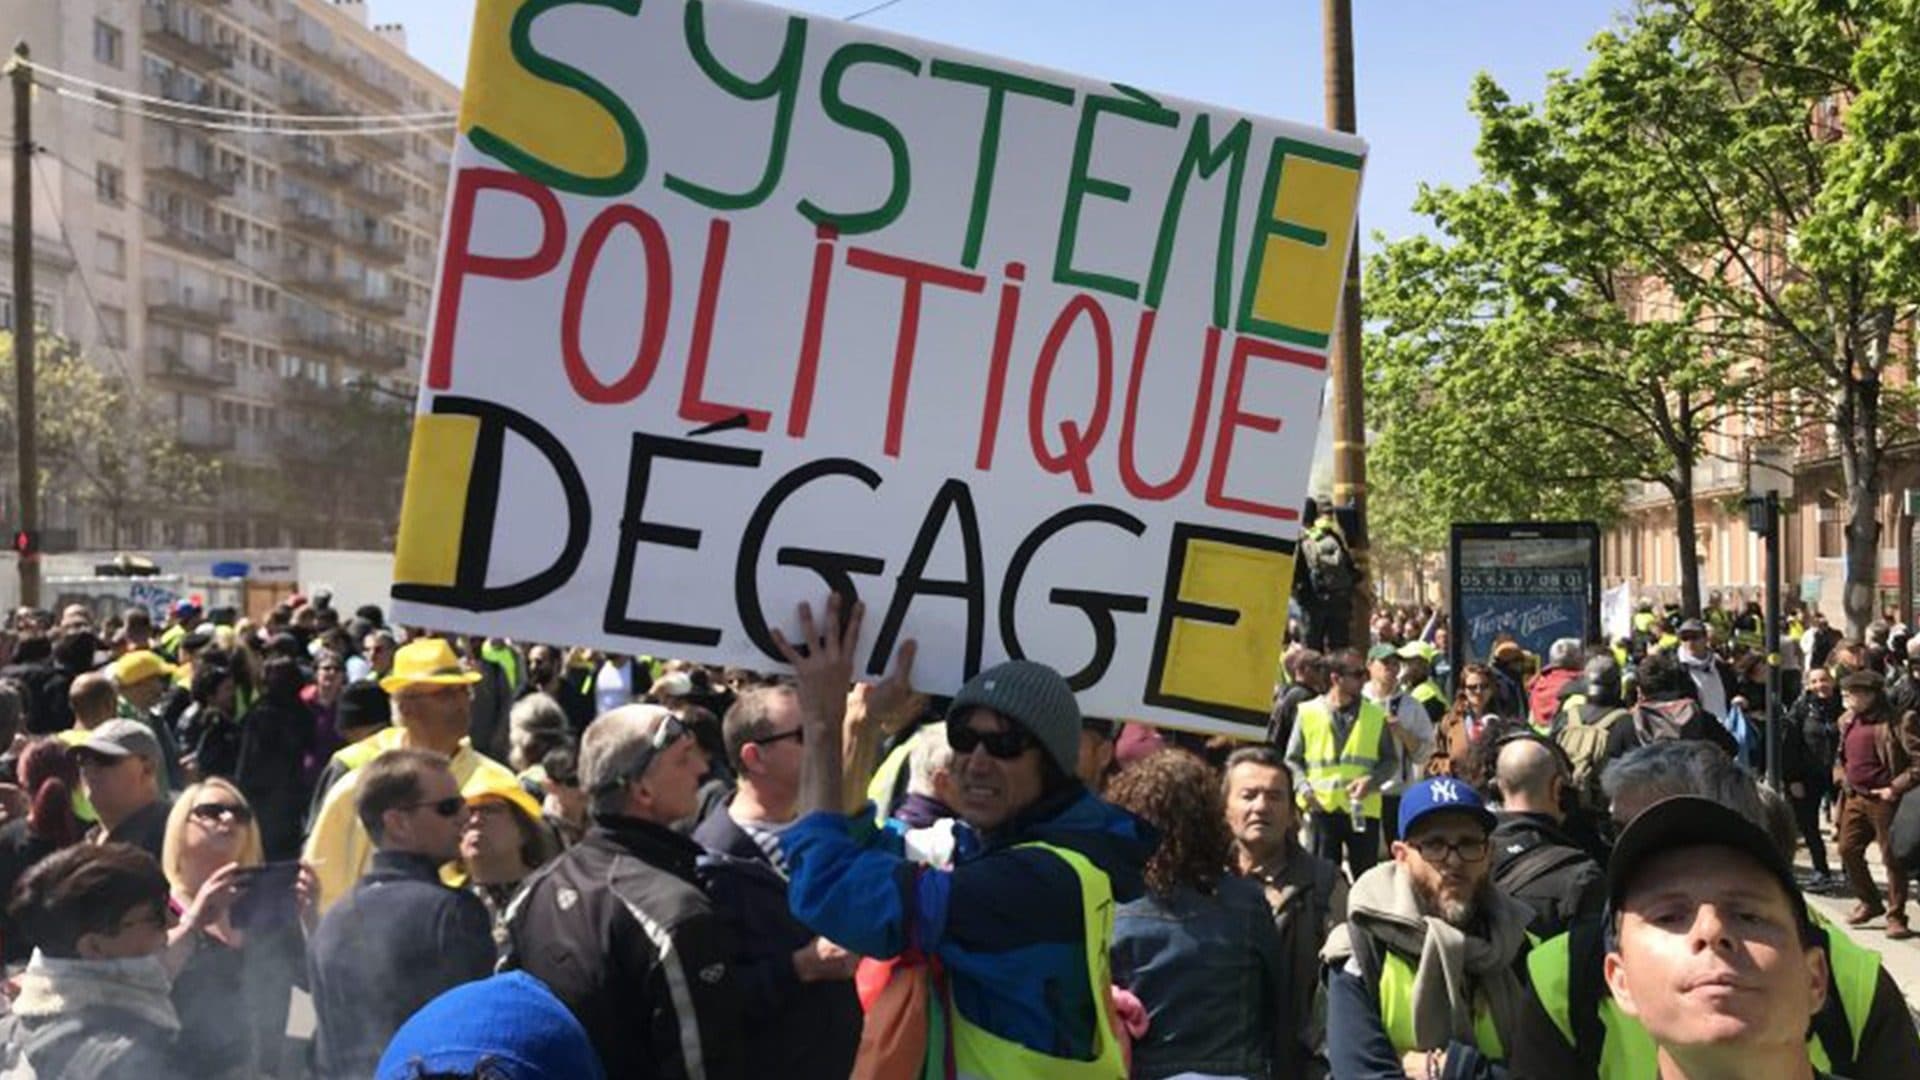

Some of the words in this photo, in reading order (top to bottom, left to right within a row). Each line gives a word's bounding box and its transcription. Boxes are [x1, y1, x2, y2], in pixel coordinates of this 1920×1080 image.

[466, 0, 1363, 348] SYSTÈME
[391, 396, 1297, 724] DÉGAGE
[1430, 780, 1458, 803] NY
